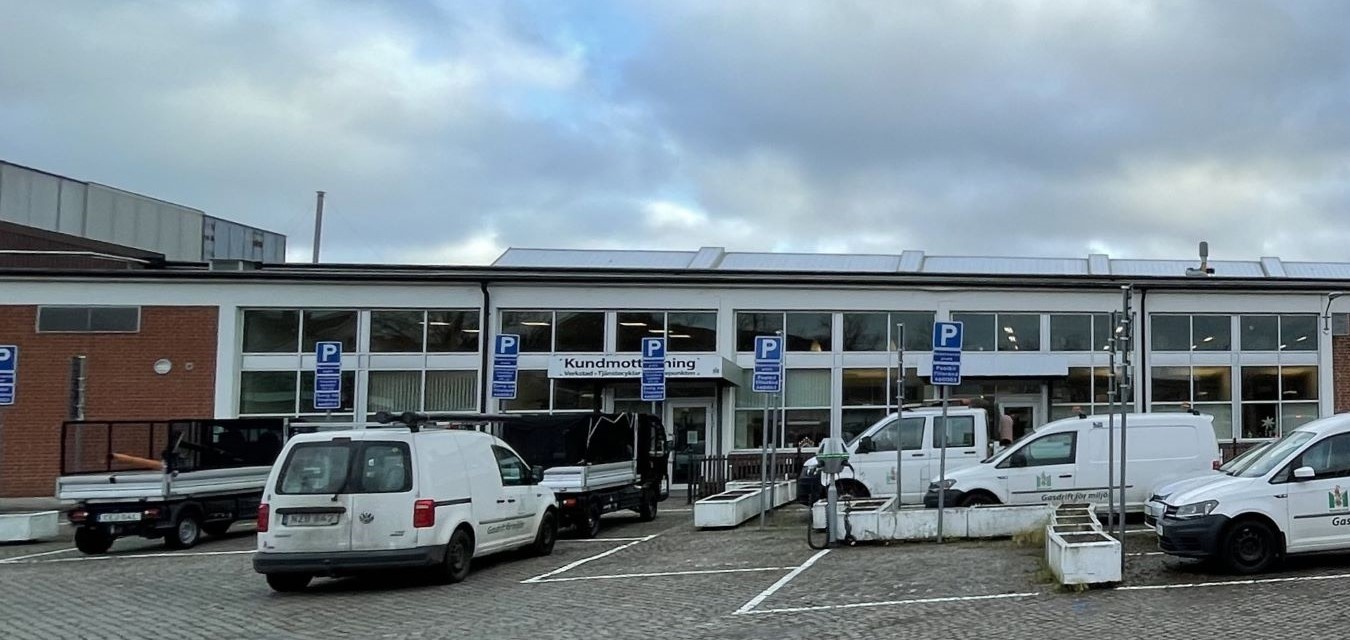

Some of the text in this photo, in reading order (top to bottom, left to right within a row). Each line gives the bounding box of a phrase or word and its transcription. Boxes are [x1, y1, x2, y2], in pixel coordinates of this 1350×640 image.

[941, 324, 957, 346] P
[323, 344, 337, 361] P
[501, 336, 515, 353] P
[648, 340, 661, 356] P
[762, 339, 777, 358] P
[565, 358, 696, 371] Kundmottning
[1041, 492, 1074, 501] Gasdrift
[1088, 491, 1109, 500] miljö
